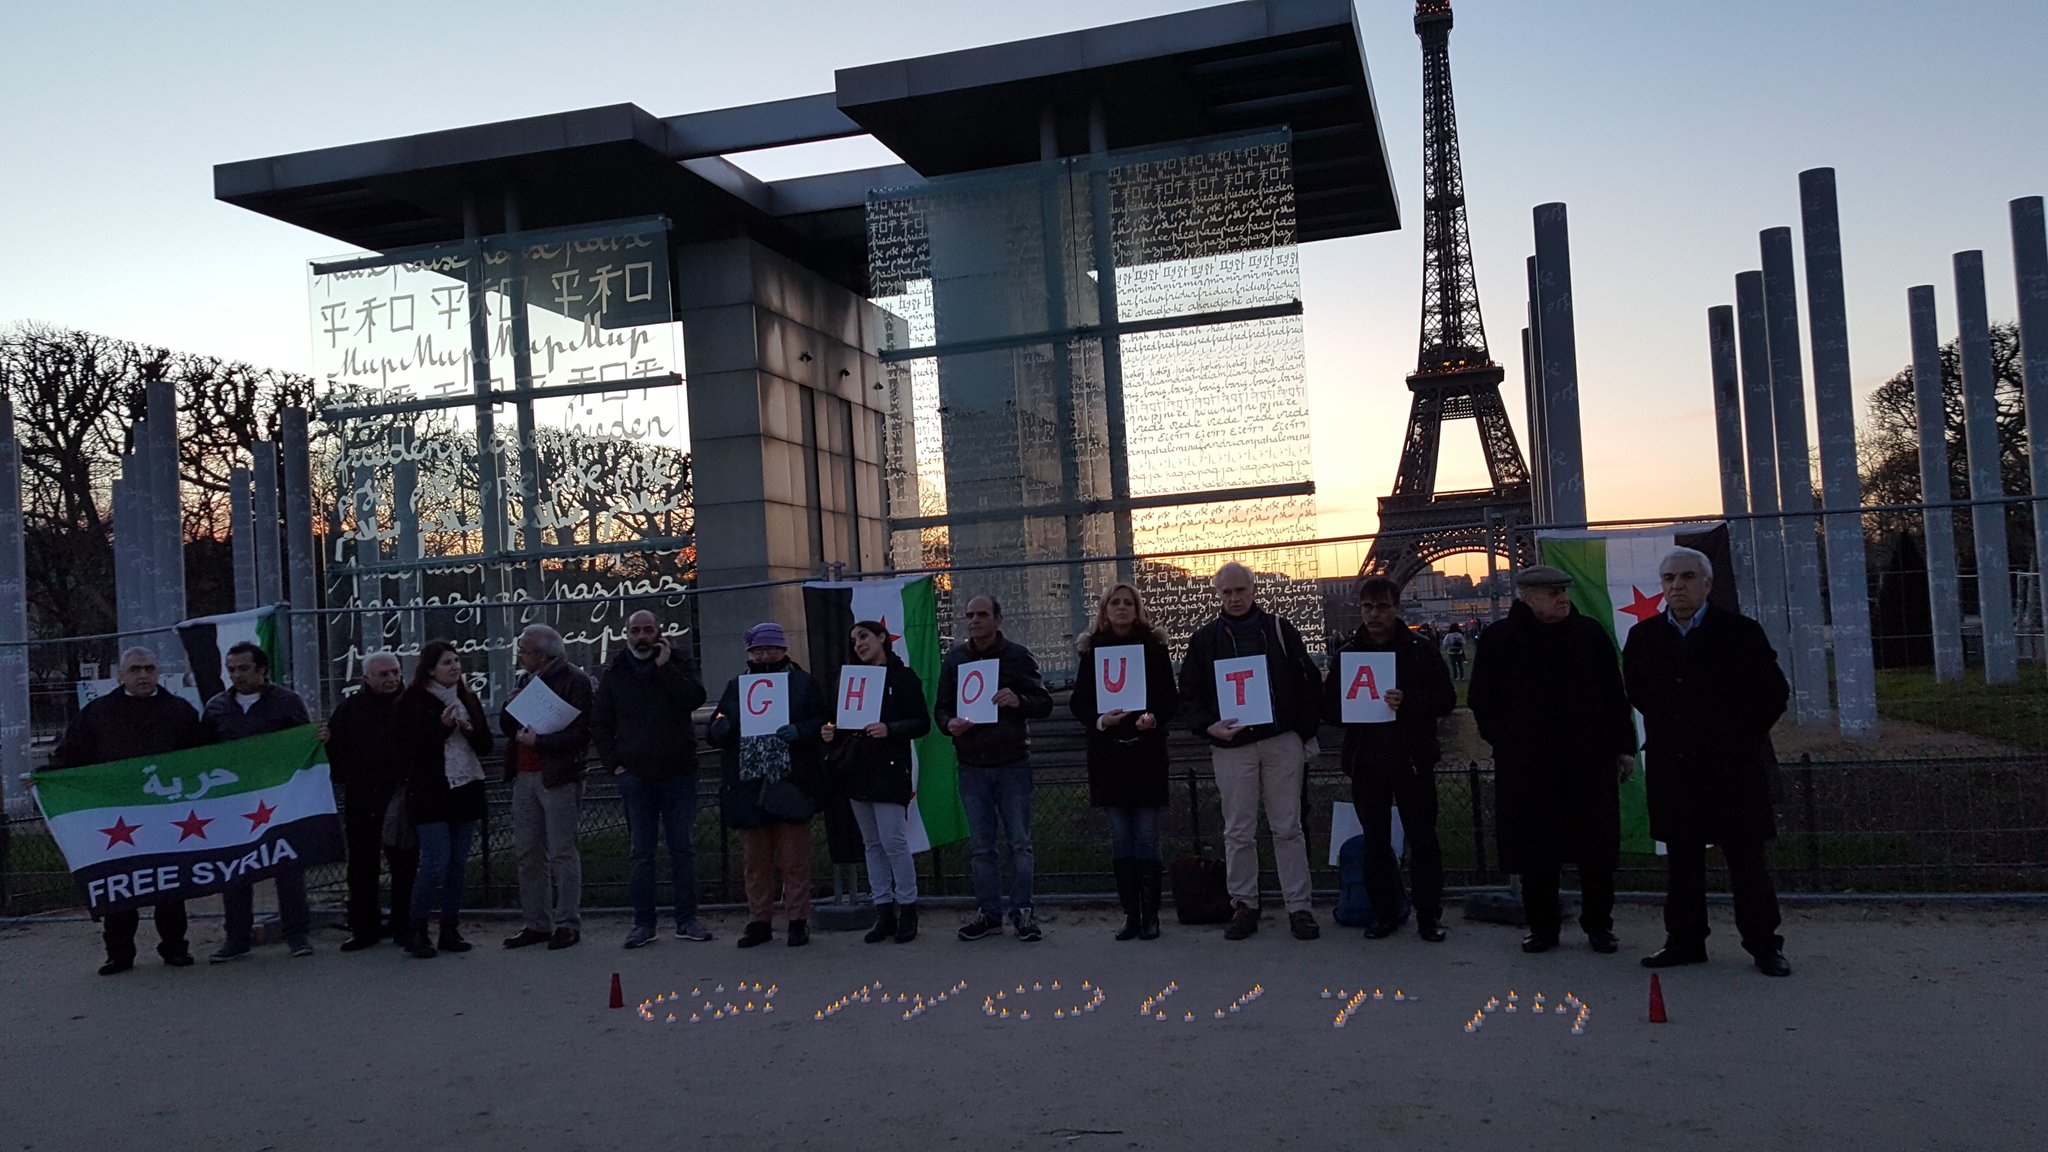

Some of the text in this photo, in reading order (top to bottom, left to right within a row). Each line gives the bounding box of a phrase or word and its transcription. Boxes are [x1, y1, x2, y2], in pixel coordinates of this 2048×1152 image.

[745, 657, 1381, 717] G H O U T A
[143, 765, 239, 800] حرية
[87, 837, 298, 909] FREE SYRIA
